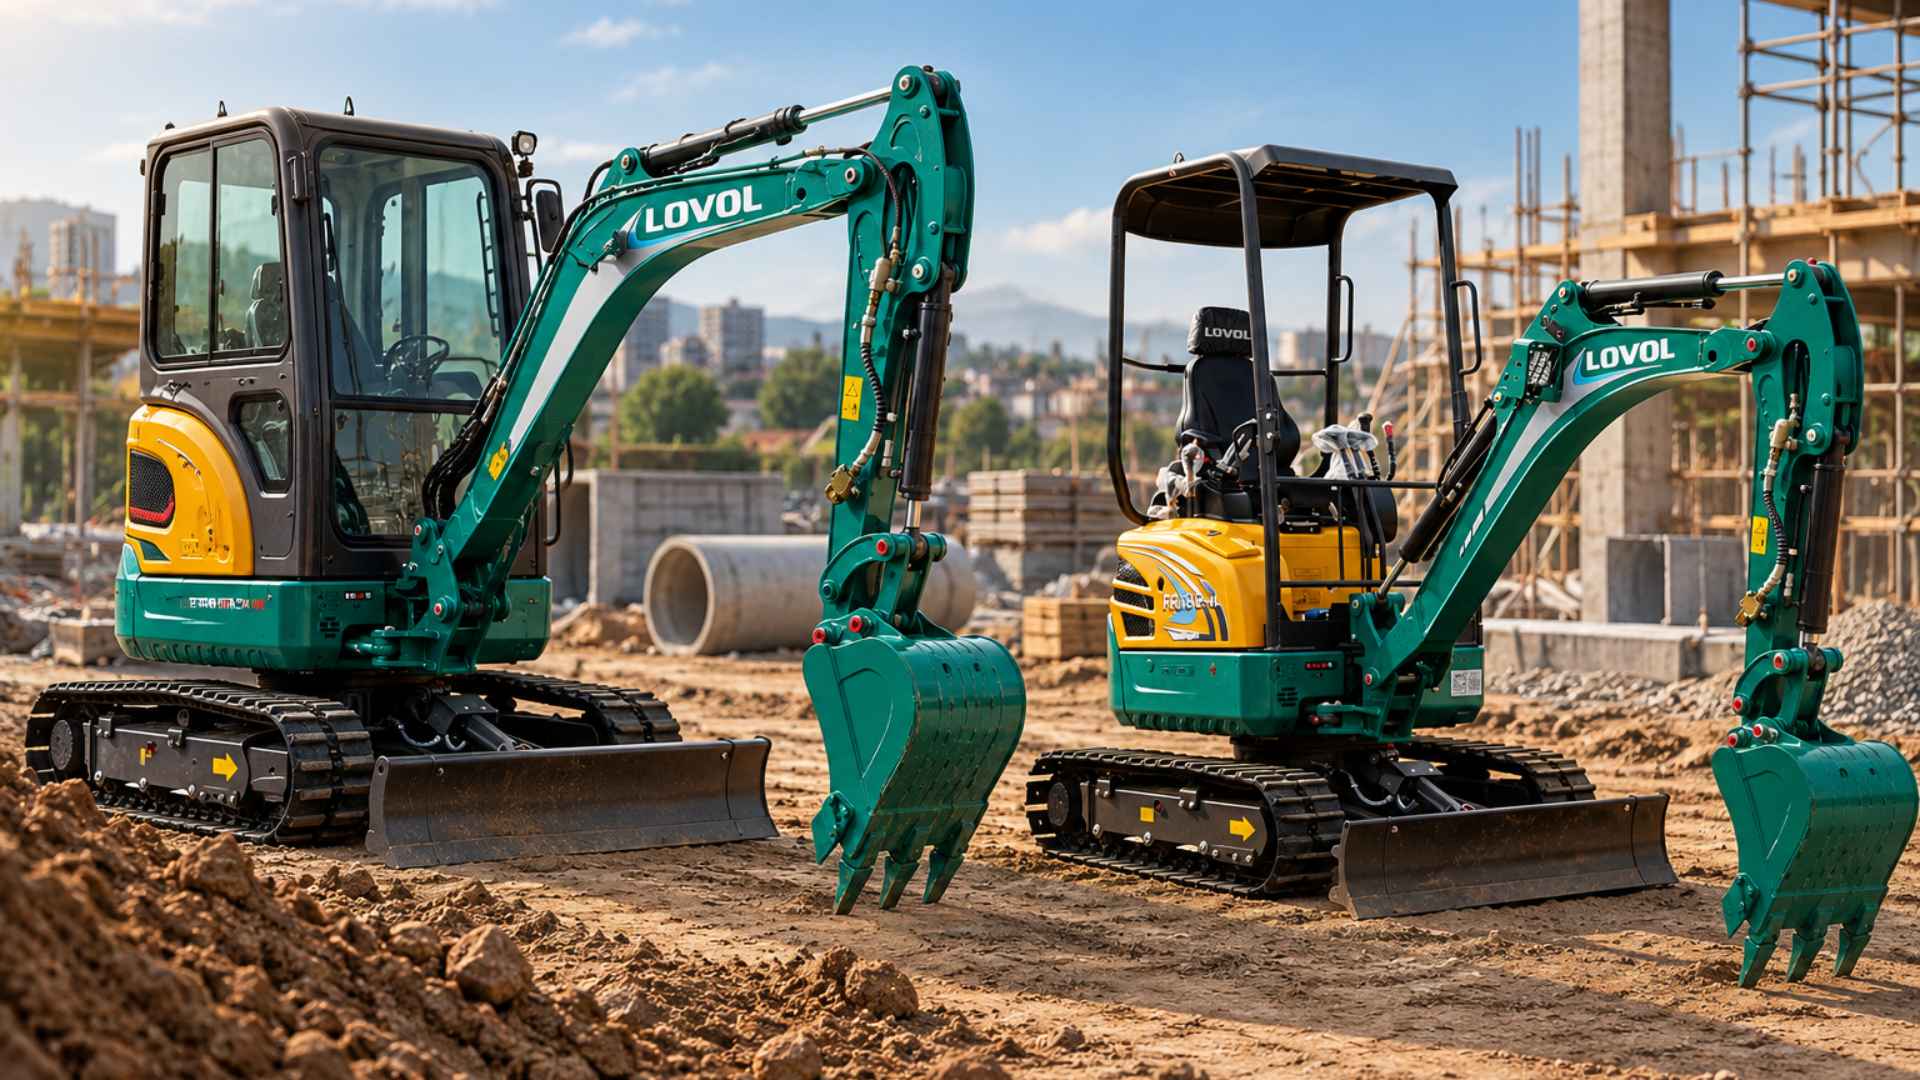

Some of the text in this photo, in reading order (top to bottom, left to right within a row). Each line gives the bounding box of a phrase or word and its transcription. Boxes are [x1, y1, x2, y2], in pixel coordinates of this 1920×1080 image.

[645, 184, 763, 233] LOVOL
[1204, 326, 1252, 340] LOVOL
[1586, 337, 1675, 371] LOVOL
